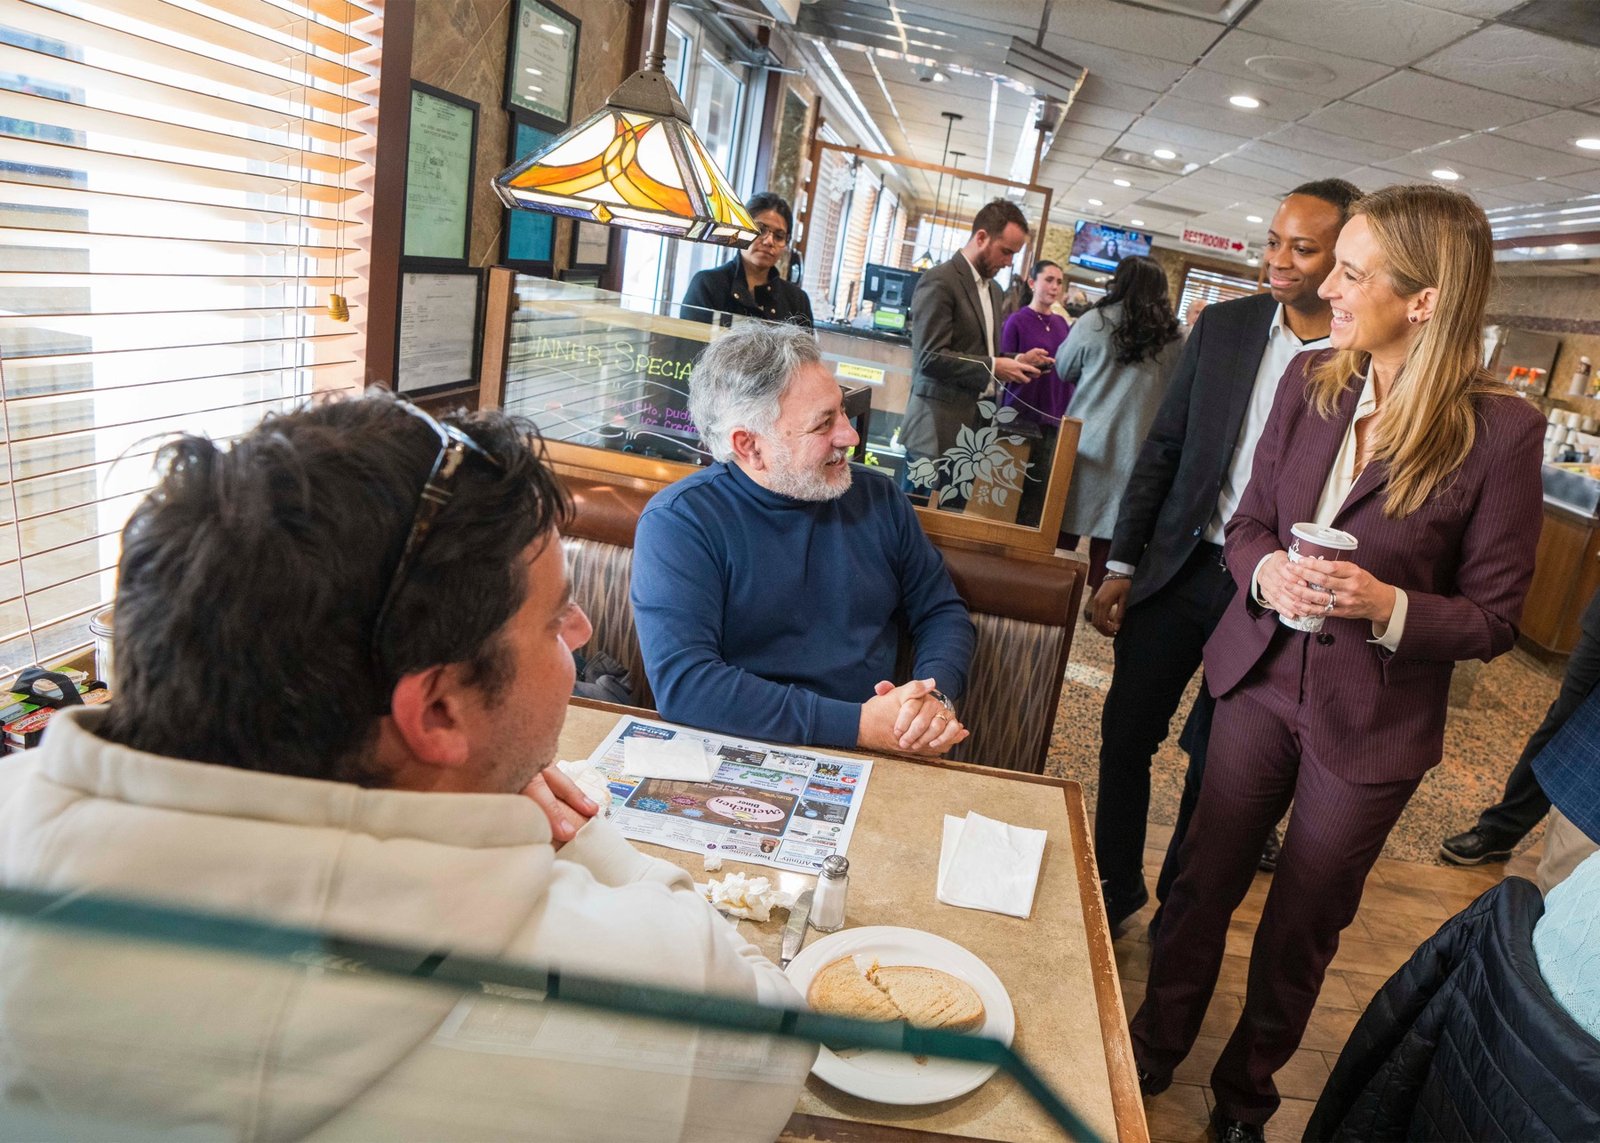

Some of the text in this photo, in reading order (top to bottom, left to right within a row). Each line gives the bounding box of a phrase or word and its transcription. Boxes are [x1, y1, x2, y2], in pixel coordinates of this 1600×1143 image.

[1183, 229, 1230, 250] RESTROOMS
[529, 335, 694, 380] INNER SPECIA
[714, 798, 781, 816] Metuchen
[736, 800, 760, 809] Diner
[754, 852, 771, 861] Your
[781, 855, 811, 867] Affinity
